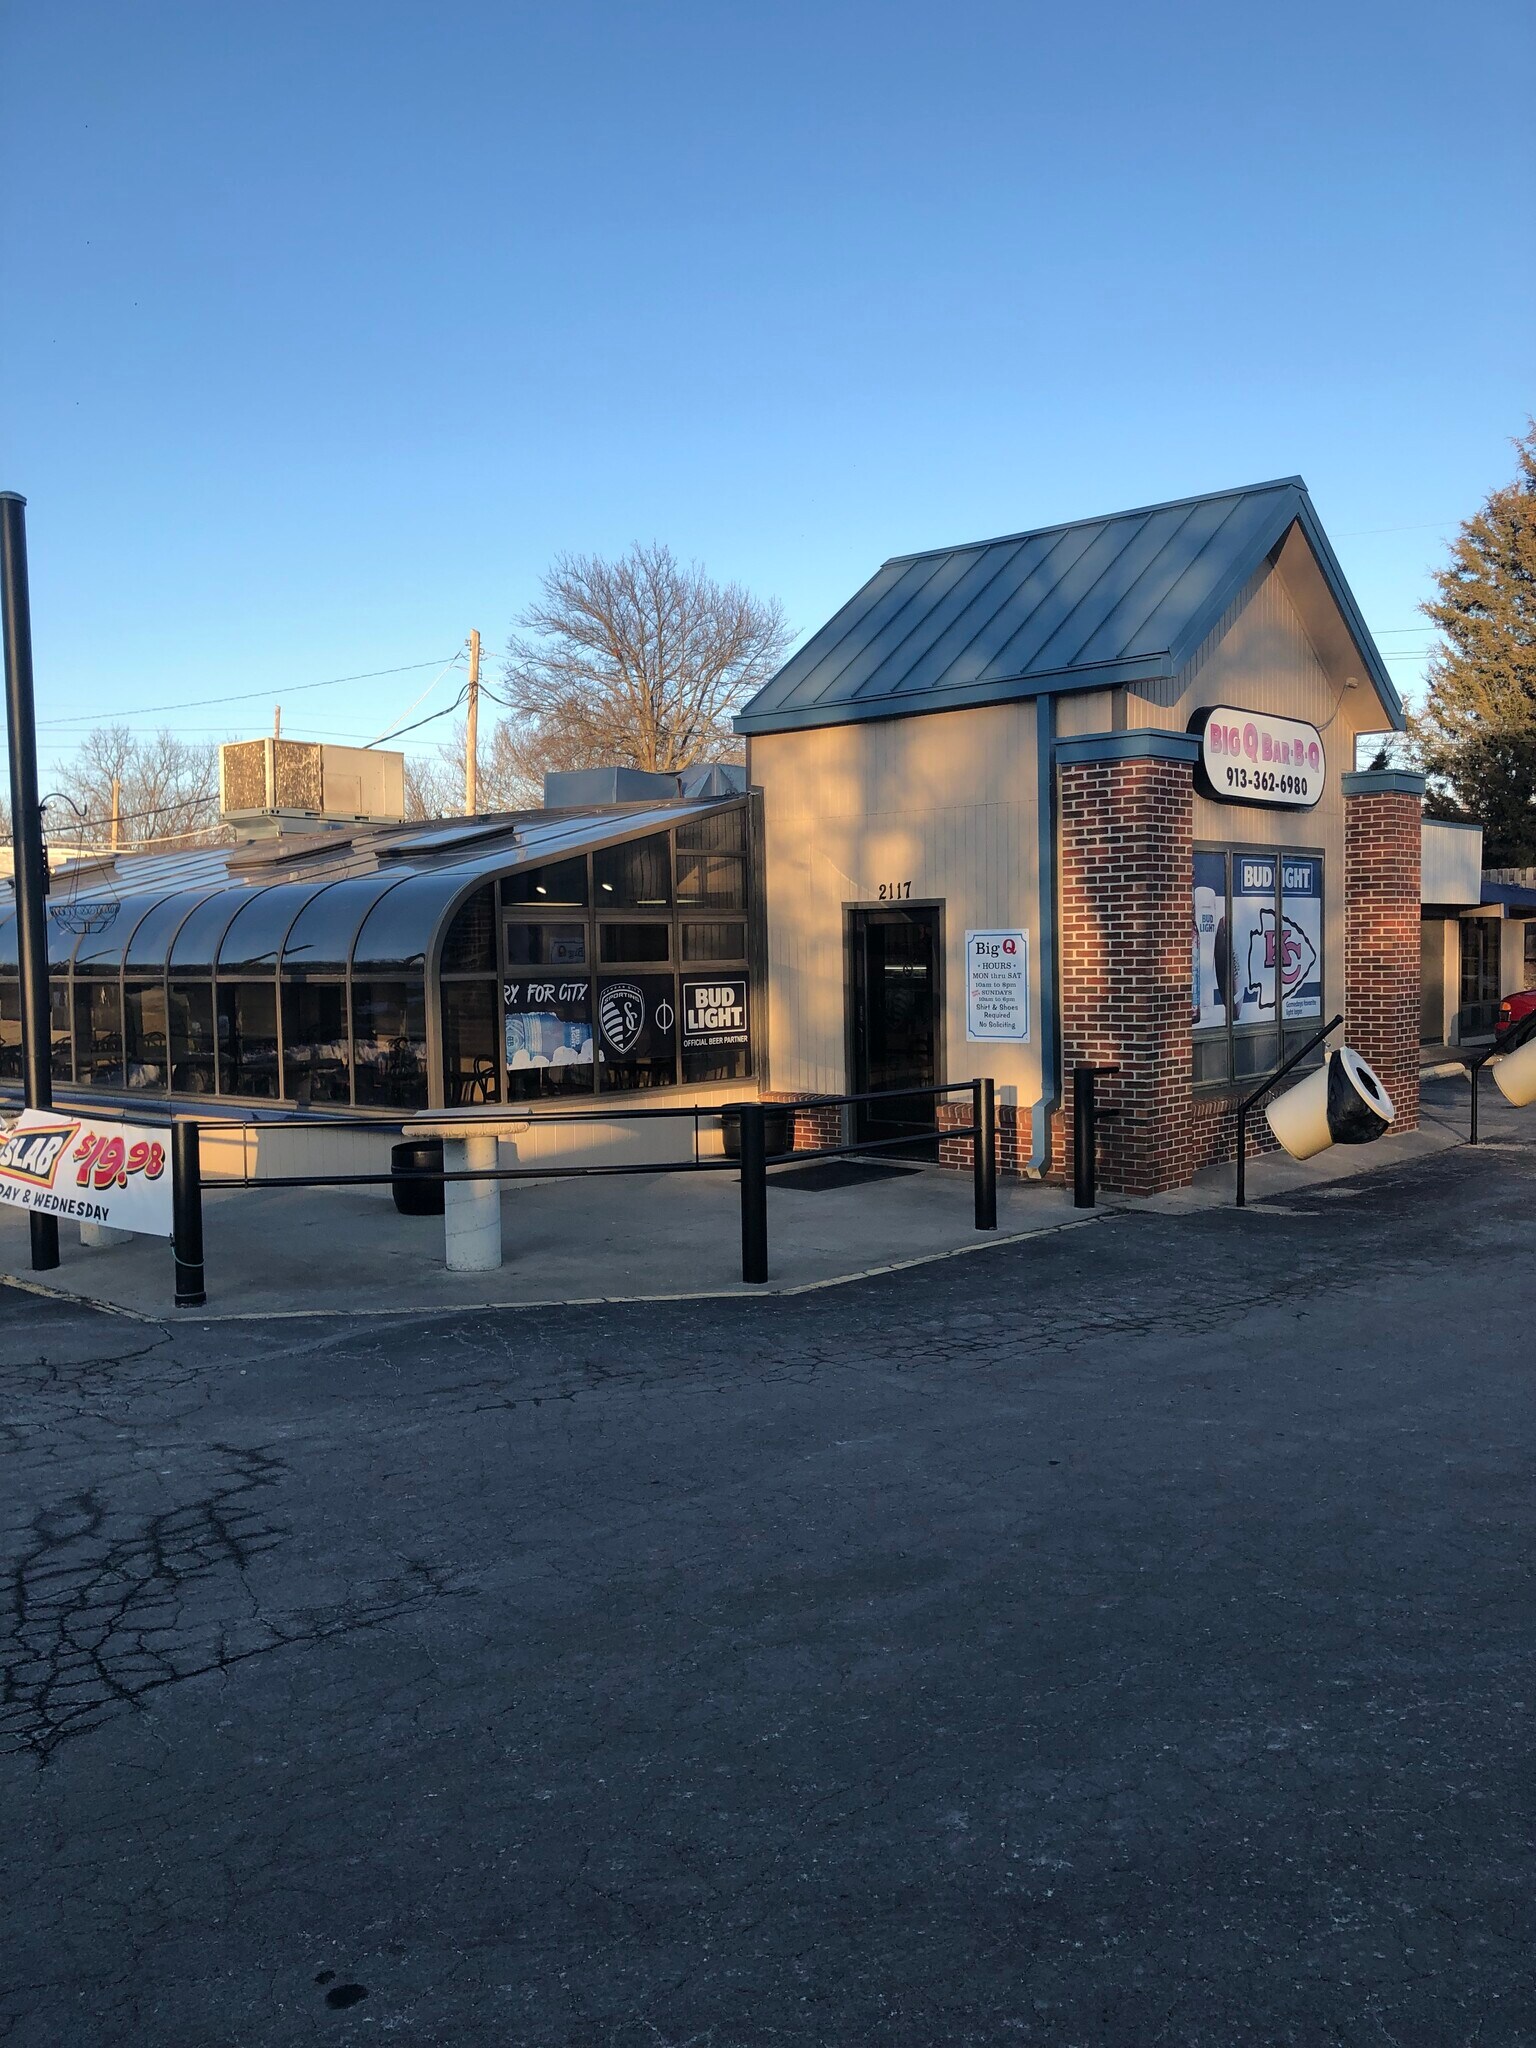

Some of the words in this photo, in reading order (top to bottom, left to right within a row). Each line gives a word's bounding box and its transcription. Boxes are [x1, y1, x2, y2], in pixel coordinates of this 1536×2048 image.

[1210, 723, 1241, 758] BIG
[1243, 722, 1259, 764] Q
[1227, 766, 1308, 796] 913-362-6980
[1244, 865, 1273, 888] BUD
[1274, 867, 1311, 889] IGHT
[878, 881, 912, 900] 2117
[1199, 923, 1215, 933] LIGHT
[1201, 914, 1214, 924] BUD
[975, 942, 1000, 958] Big
[1002, 938, 1017, 955] Q
[982, 962, 1012, 970] HOURS
[526, 983, 557, 1004] FOR
[603, 991, 641, 1005] SPORTING
[695, 987, 735, 1009] BUD
[976, 1003, 991, 1011] Shirt
[991, 1003, 998, 1011] &
[999, 1003, 1019, 1011] Shoes
[983, 1011, 1011, 1020] Required
[687, 1006, 743, 1030] LIGHT
[988, 1021, 1016, 1030] Soliciting
[683, 1038, 708, 1048] OFFICIAL
[708, 1036, 724, 1046] BEER
[723, 1034, 749, 1044] PARTNER
[0, 1136, 64, 1176] SLAB
[72, 1129, 166, 1191] $19.98
[22, 1189, 31, 1203] &
[33, 1192, 110, 1221] WEDNESDAY
